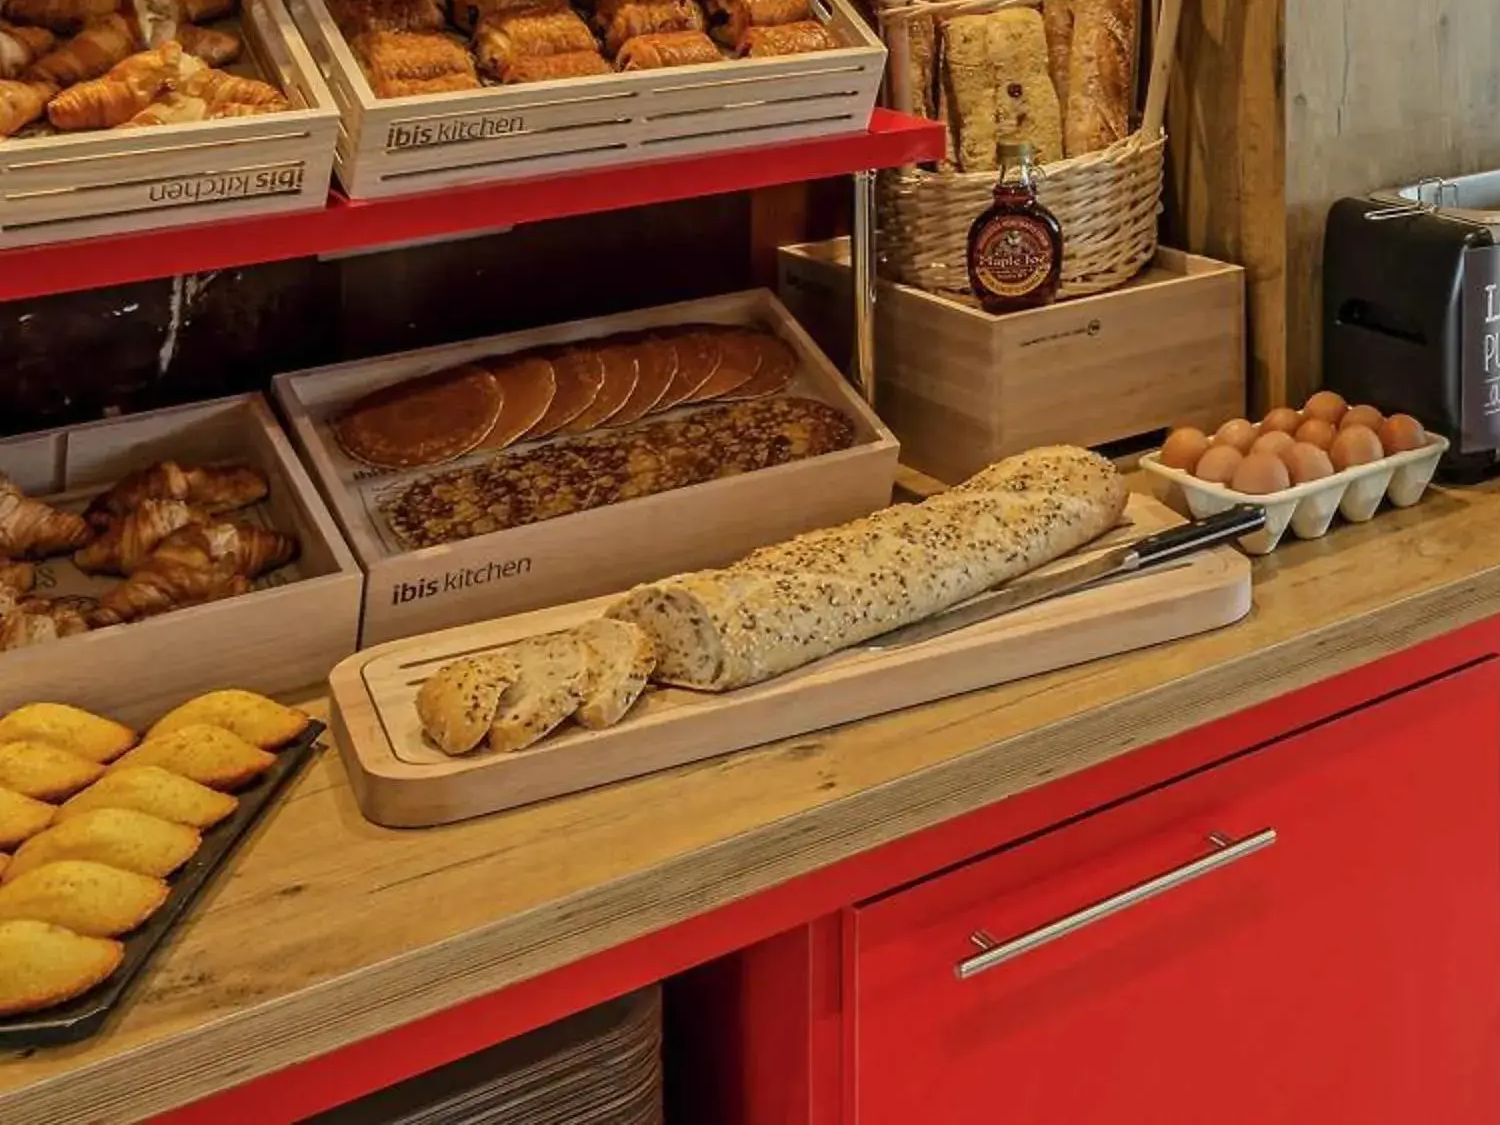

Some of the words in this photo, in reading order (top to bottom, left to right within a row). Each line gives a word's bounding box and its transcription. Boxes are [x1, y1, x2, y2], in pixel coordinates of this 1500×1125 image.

[386, 125, 432, 148] ibis
[437, 116, 524, 142] kitchen
[149, 175, 249, 201] kitchen
[255, 169, 304, 190] ibis
[391, 578, 440, 606] ibis
[443, 557, 533, 593] kitchen
